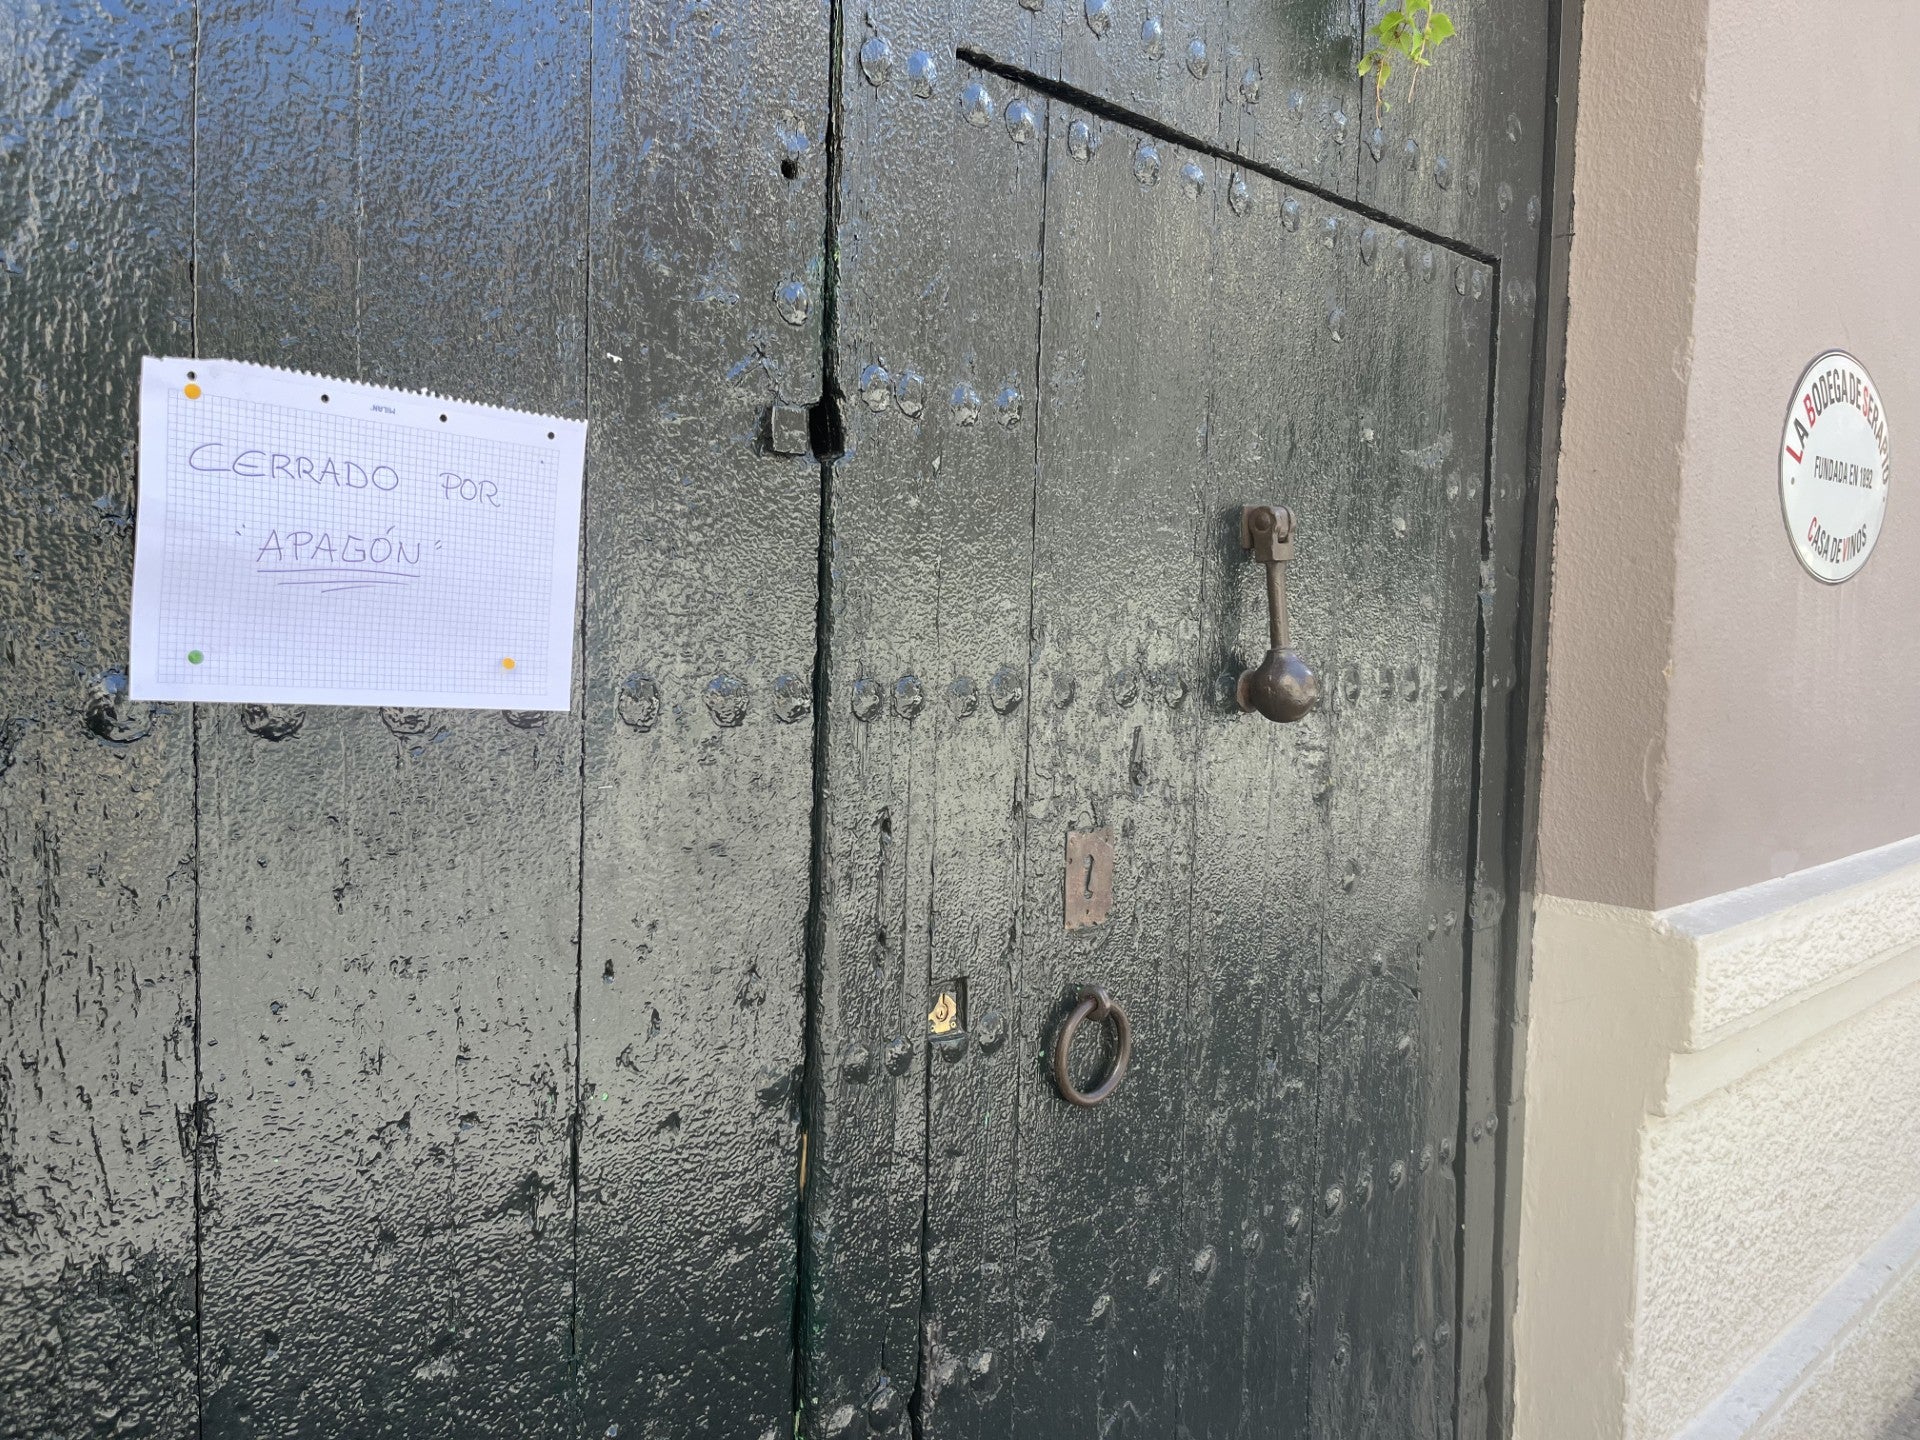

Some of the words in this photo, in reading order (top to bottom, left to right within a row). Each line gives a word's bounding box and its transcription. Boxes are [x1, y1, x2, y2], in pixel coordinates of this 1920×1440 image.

[1786, 418, 1809, 464] LA
[1803, 368, 1848, 429] BODEGA
[1849, 371, 1862, 411] DE
[1862, 385, 1889, 485] SERAPIO
[188, 442, 400, 491] CERRADO
[439, 471, 501, 507] POR
[1814, 455, 1848, 485] FUNDADA
[1848, 463, 1859, 487] EN
[1859, 466, 1873, 490] 1892
[1807, 516, 1831, 562] CASA
[1830, 537, 1842, 564] DE
[1842, 523, 1867, 562] VINOS
